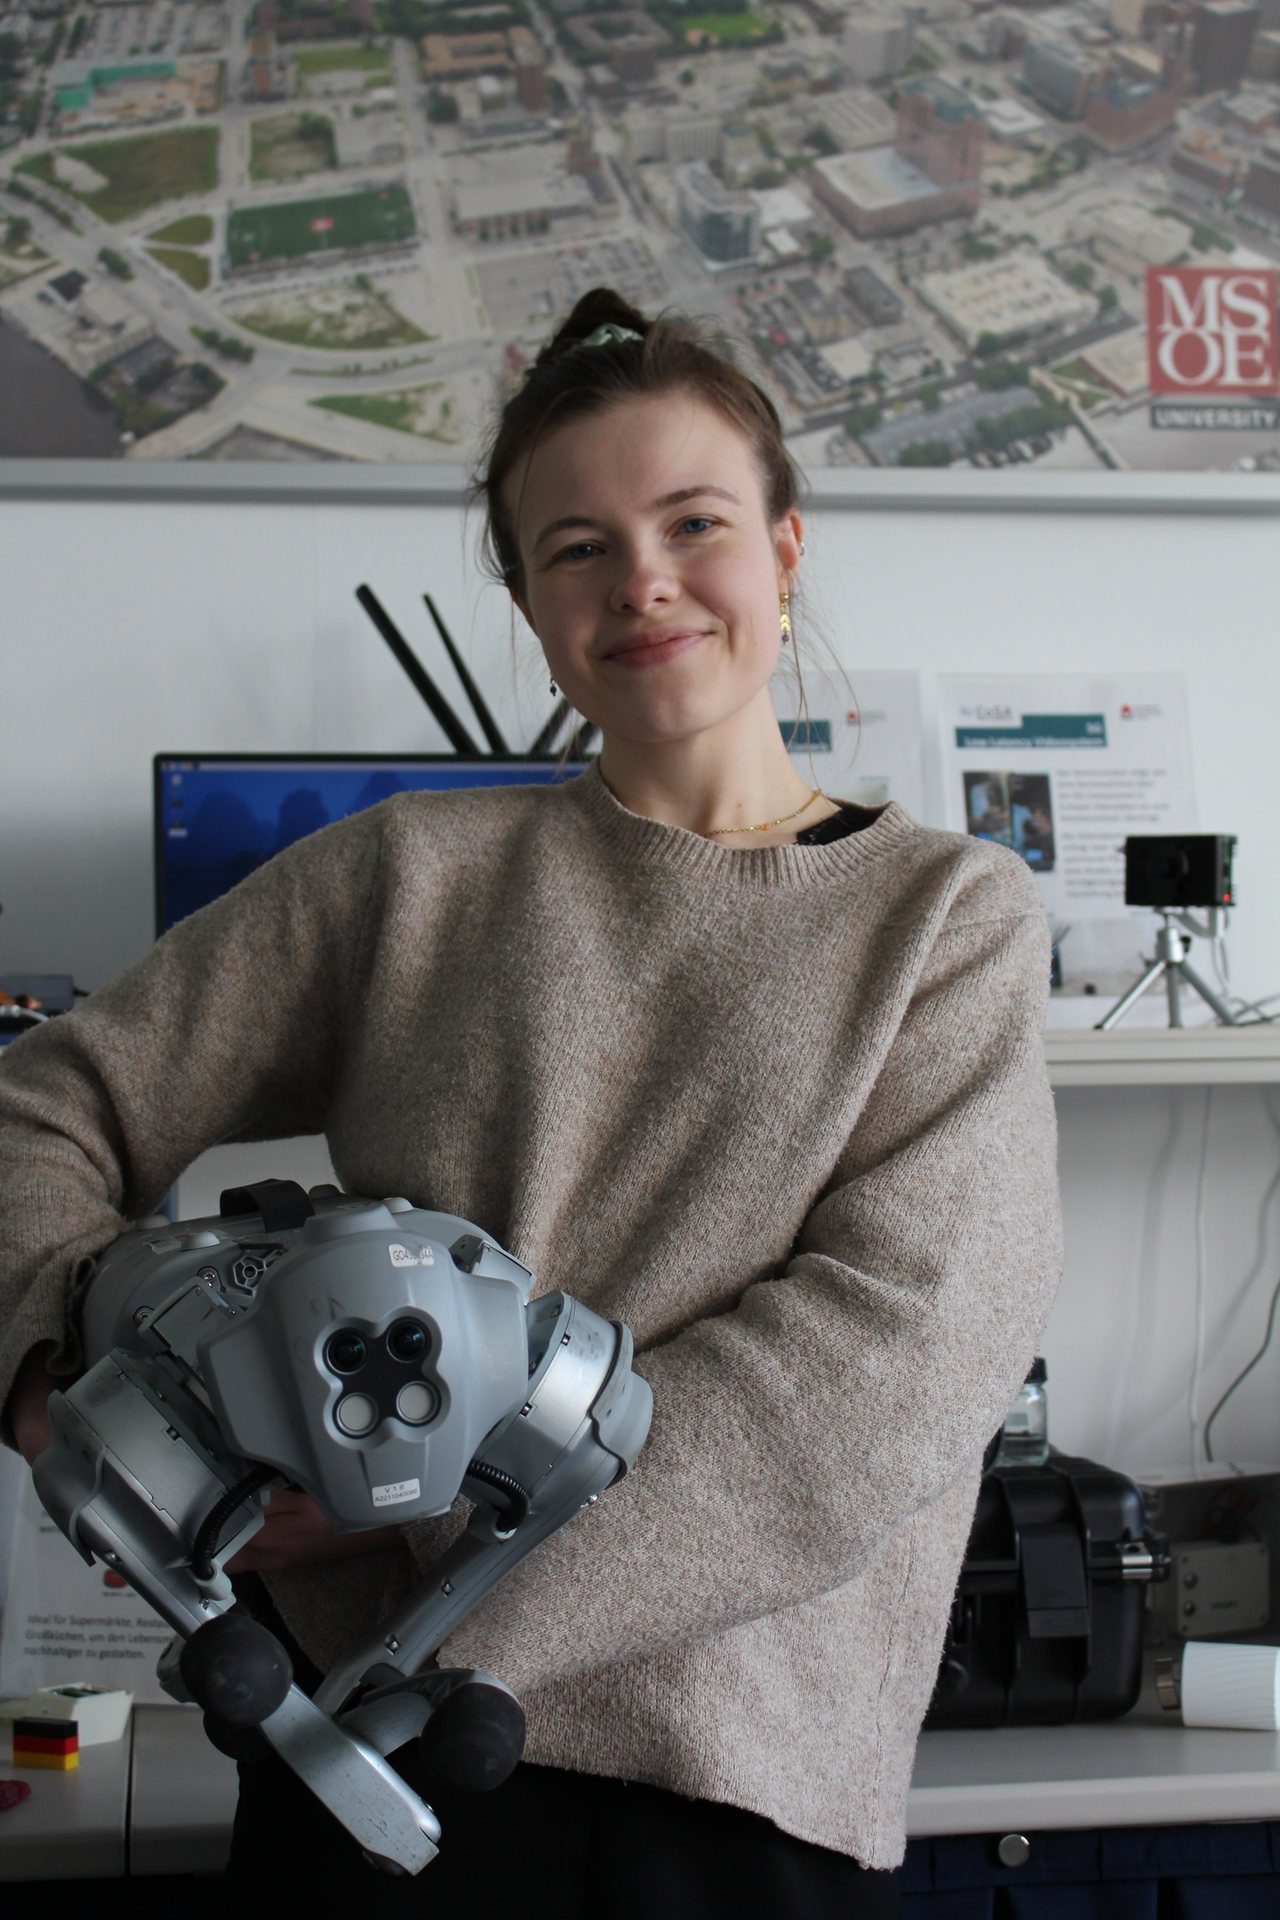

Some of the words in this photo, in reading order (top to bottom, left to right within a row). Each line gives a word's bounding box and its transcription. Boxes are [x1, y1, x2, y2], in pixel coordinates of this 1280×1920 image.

[1154, 407, 1276, 427] UNIVERSITY
[53, 1614, 67, 1625] für
[89, 1633, 105, 1642] um
[107, 1631, 126, 1642] den
